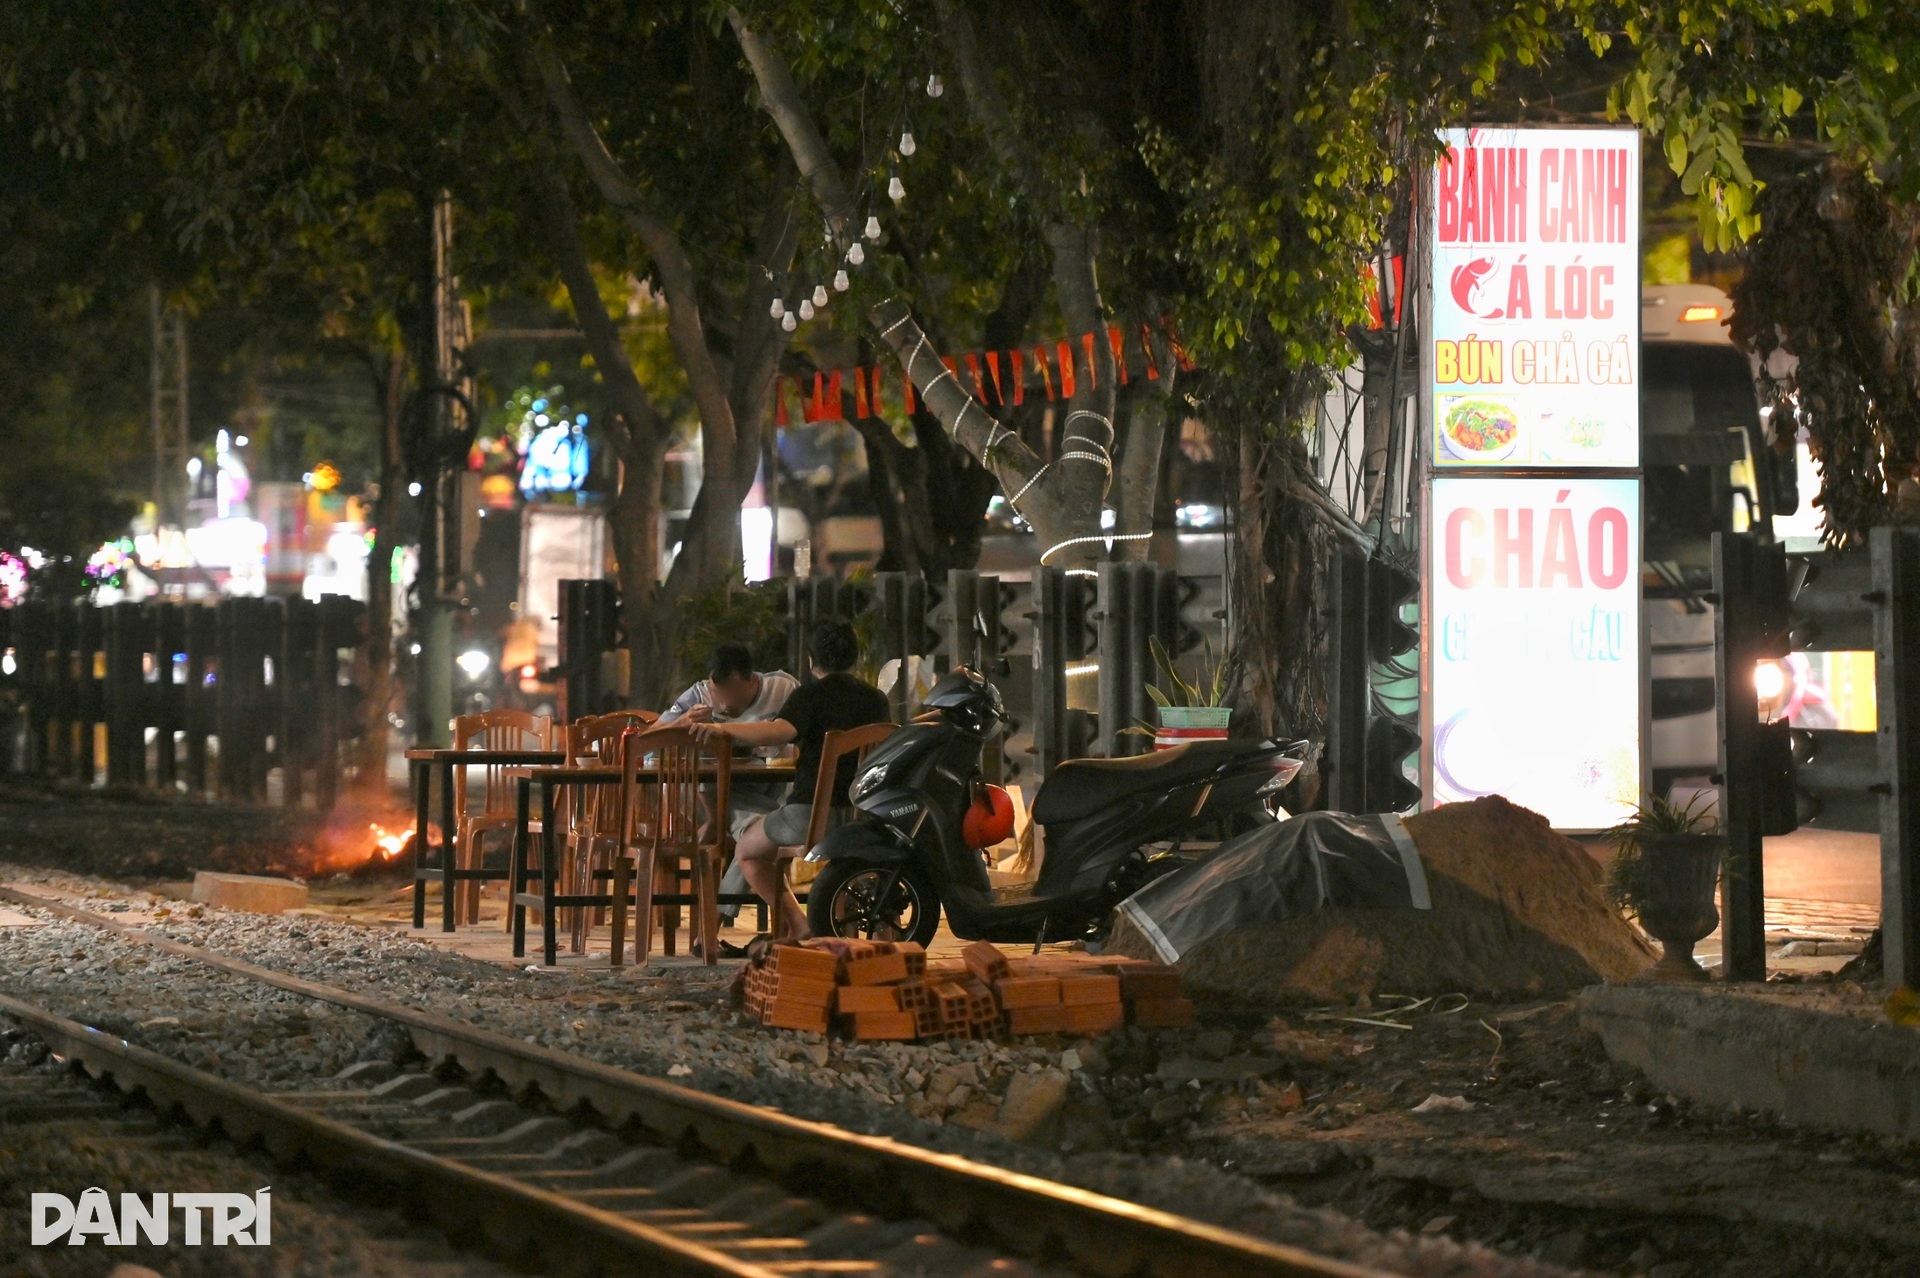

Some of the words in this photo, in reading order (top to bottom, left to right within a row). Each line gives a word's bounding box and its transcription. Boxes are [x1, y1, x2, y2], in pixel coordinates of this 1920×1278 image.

[1438, 128, 1528, 243] BÁNH
[1539, 148, 1627, 243] CANH
[1545, 254, 1614, 320] LÓC
[1435, 333, 1503, 384] BÚN
[1512, 330, 1579, 384] CHẢ
[1587, 334, 1632, 385] CÁ
[1445, 489, 1628, 590] CHÁO
[890, 803, 918, 818] YAMAHA
